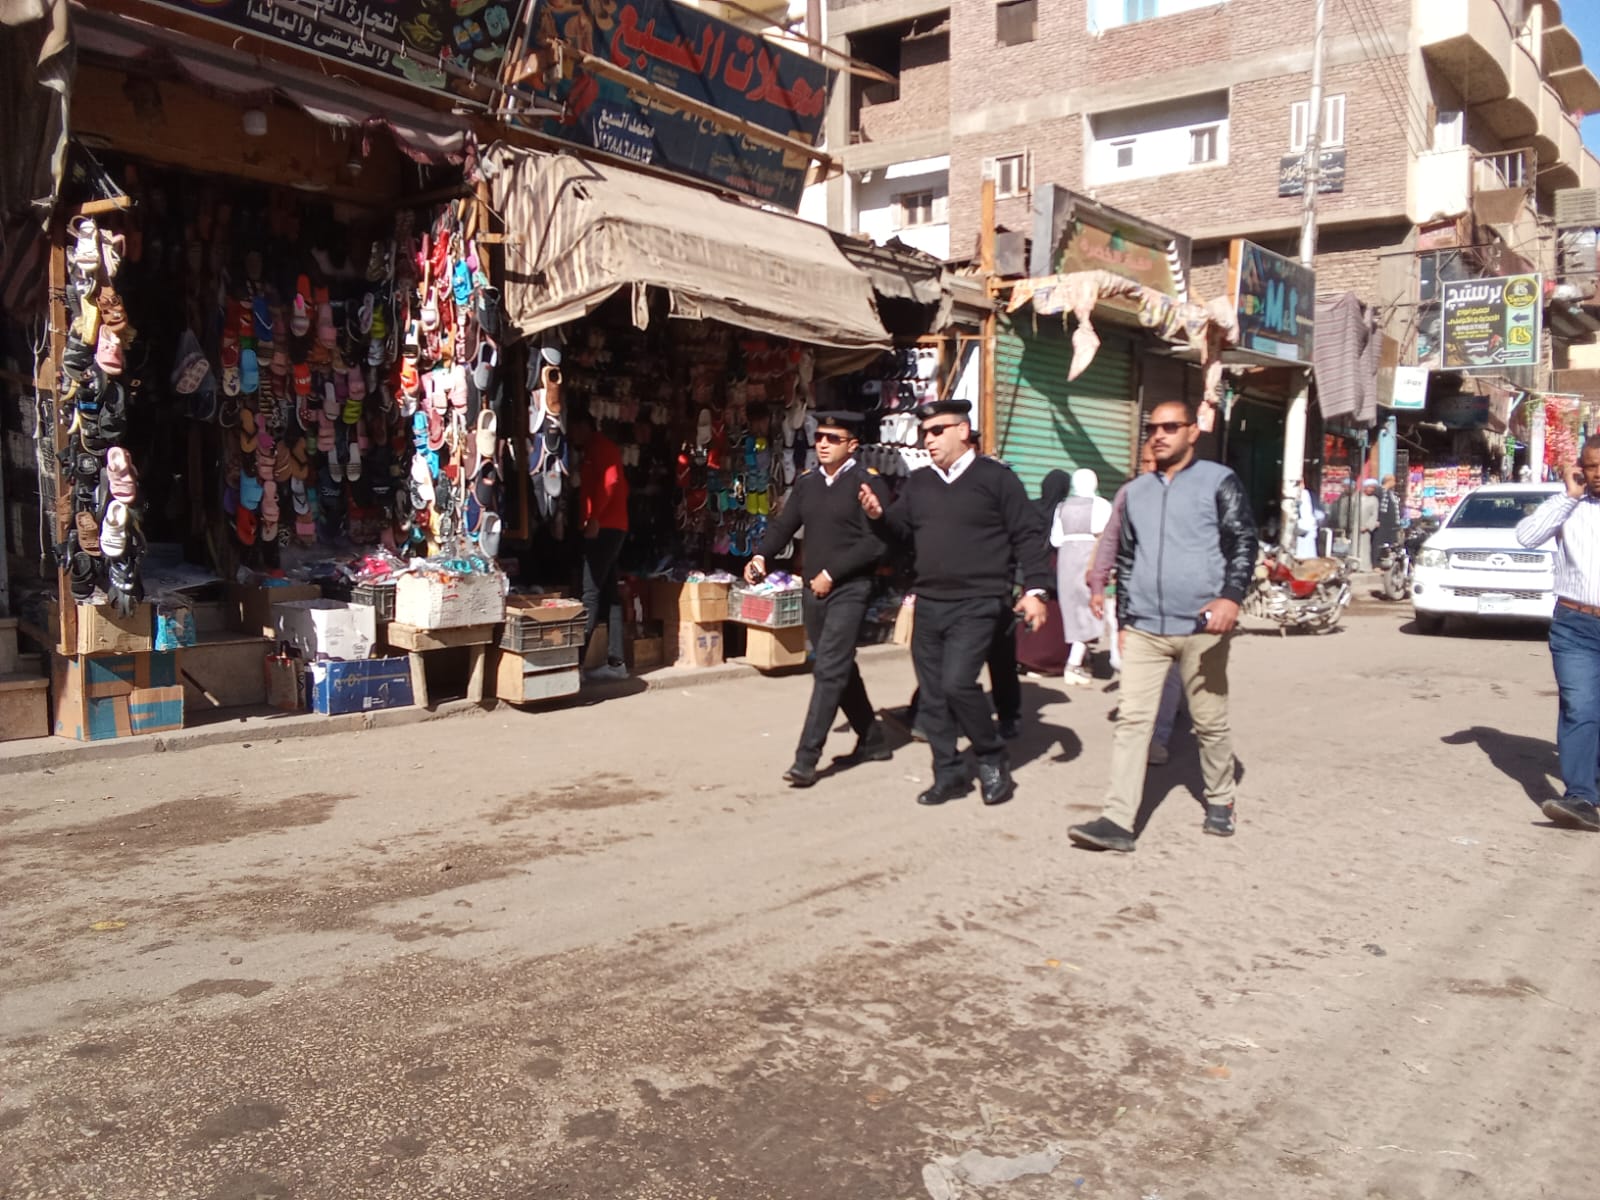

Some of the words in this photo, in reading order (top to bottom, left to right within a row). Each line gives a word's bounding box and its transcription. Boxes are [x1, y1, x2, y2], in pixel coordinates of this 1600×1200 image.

[611, 4, 725, 80] السبع
[723, 34, 825, 118] محلات
[598, 109, 629, 130] السبع
[628, 117, 655, 138] محمد
